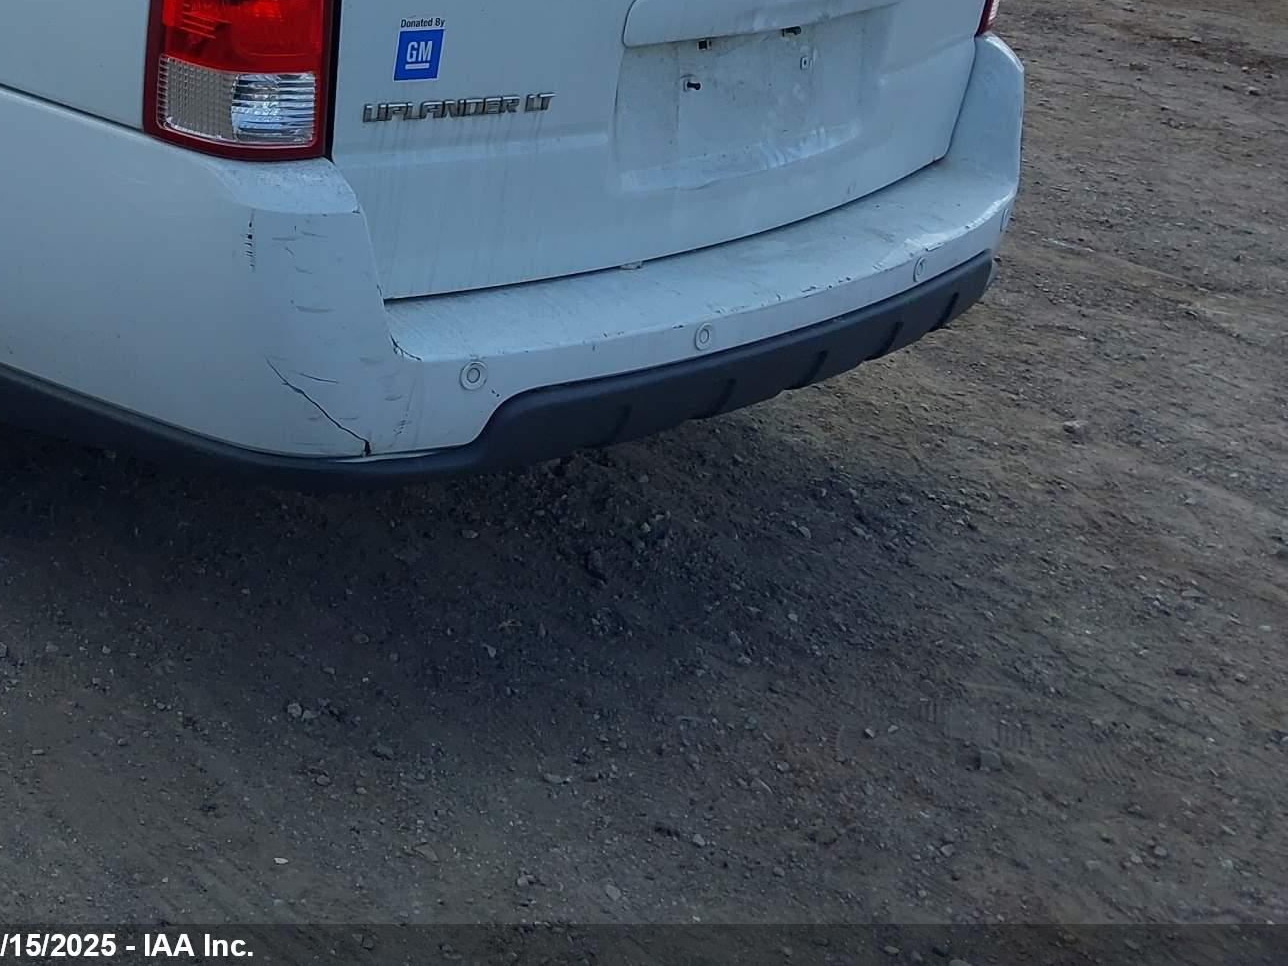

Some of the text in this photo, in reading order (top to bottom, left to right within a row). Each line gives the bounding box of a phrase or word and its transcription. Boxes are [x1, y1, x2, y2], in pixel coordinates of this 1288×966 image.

[400, 17, 446, 28] Donated By
[406, 40, 433, 63] GM
[363, 92, 556, 123] UPLANDER LT
